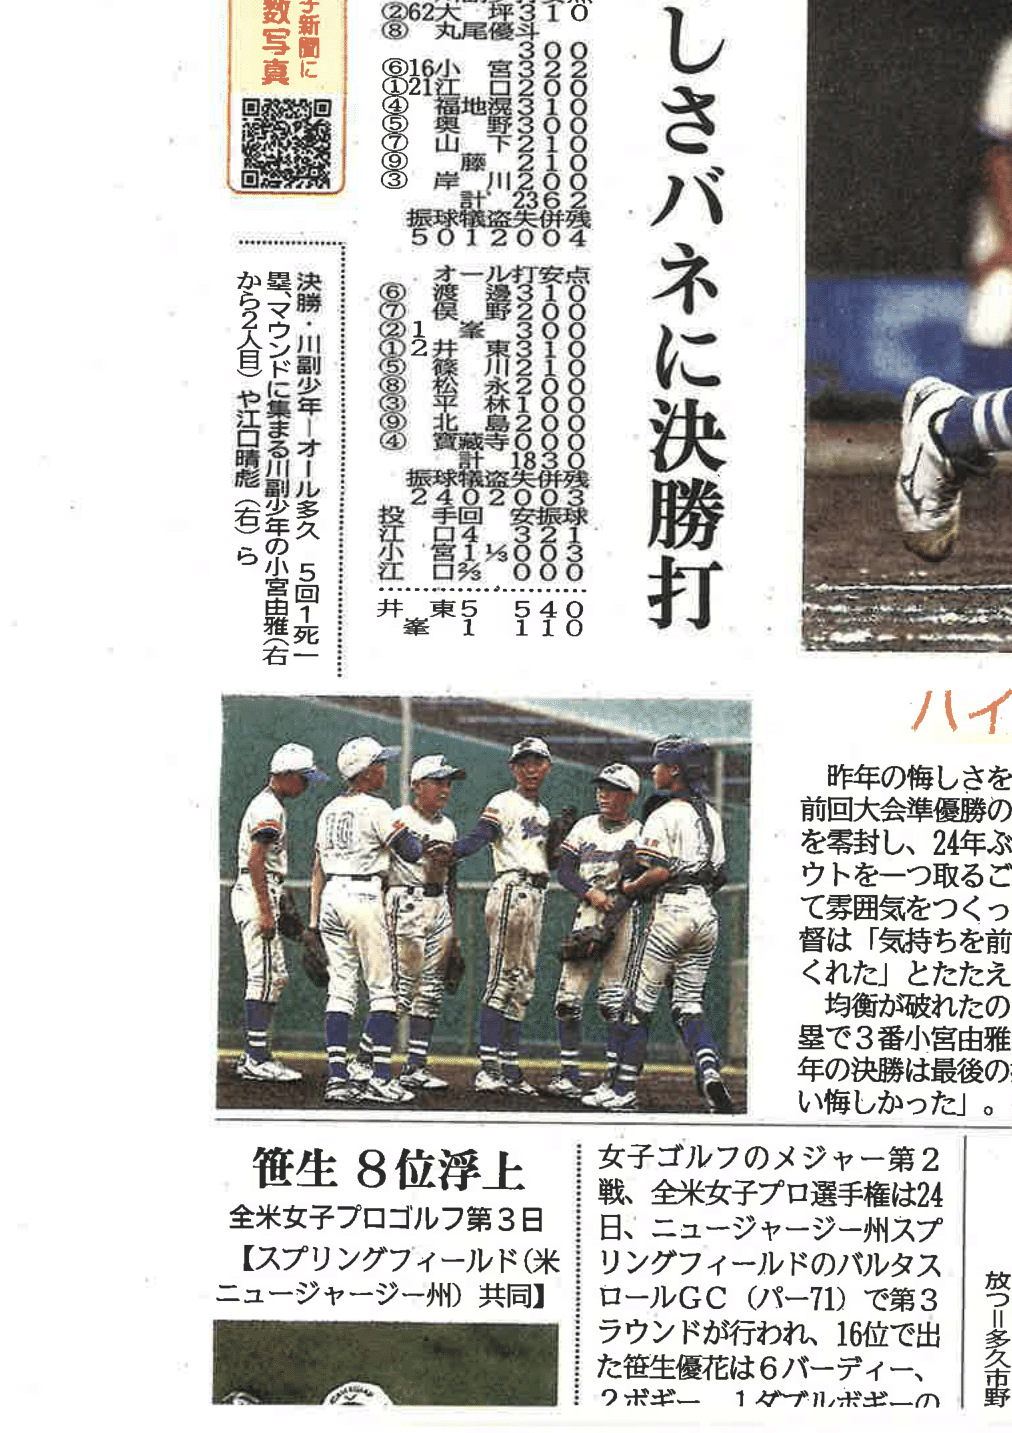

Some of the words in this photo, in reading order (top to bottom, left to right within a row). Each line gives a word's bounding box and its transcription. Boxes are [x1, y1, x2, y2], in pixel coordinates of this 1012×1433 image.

[252, 1146, 338, 1189] 笹生
[357, 1148, 525, 1191] 8位浮上
[598, 1144, 938, 1172] 女子ゴルフのメジャー第2
[598, 1178, 943, 1207] 戦、全米女子プロ選手権は24
[230, 1204, 542, 1232] 全米女子プロゴルフ第3日
[601, 1214, 943, 1243] 日、ニュージャージー州スプ
[602, 1250, 940, 1277] リングフィールドのバルタス
[600, 1286, 937, 1312] ロールGC（パー71）で第3
[599, 1319, 940, 1348] ラウンドが行われ、16位で出
[598, 1354, 922, 1381] た笹生優花は6バーディー、
